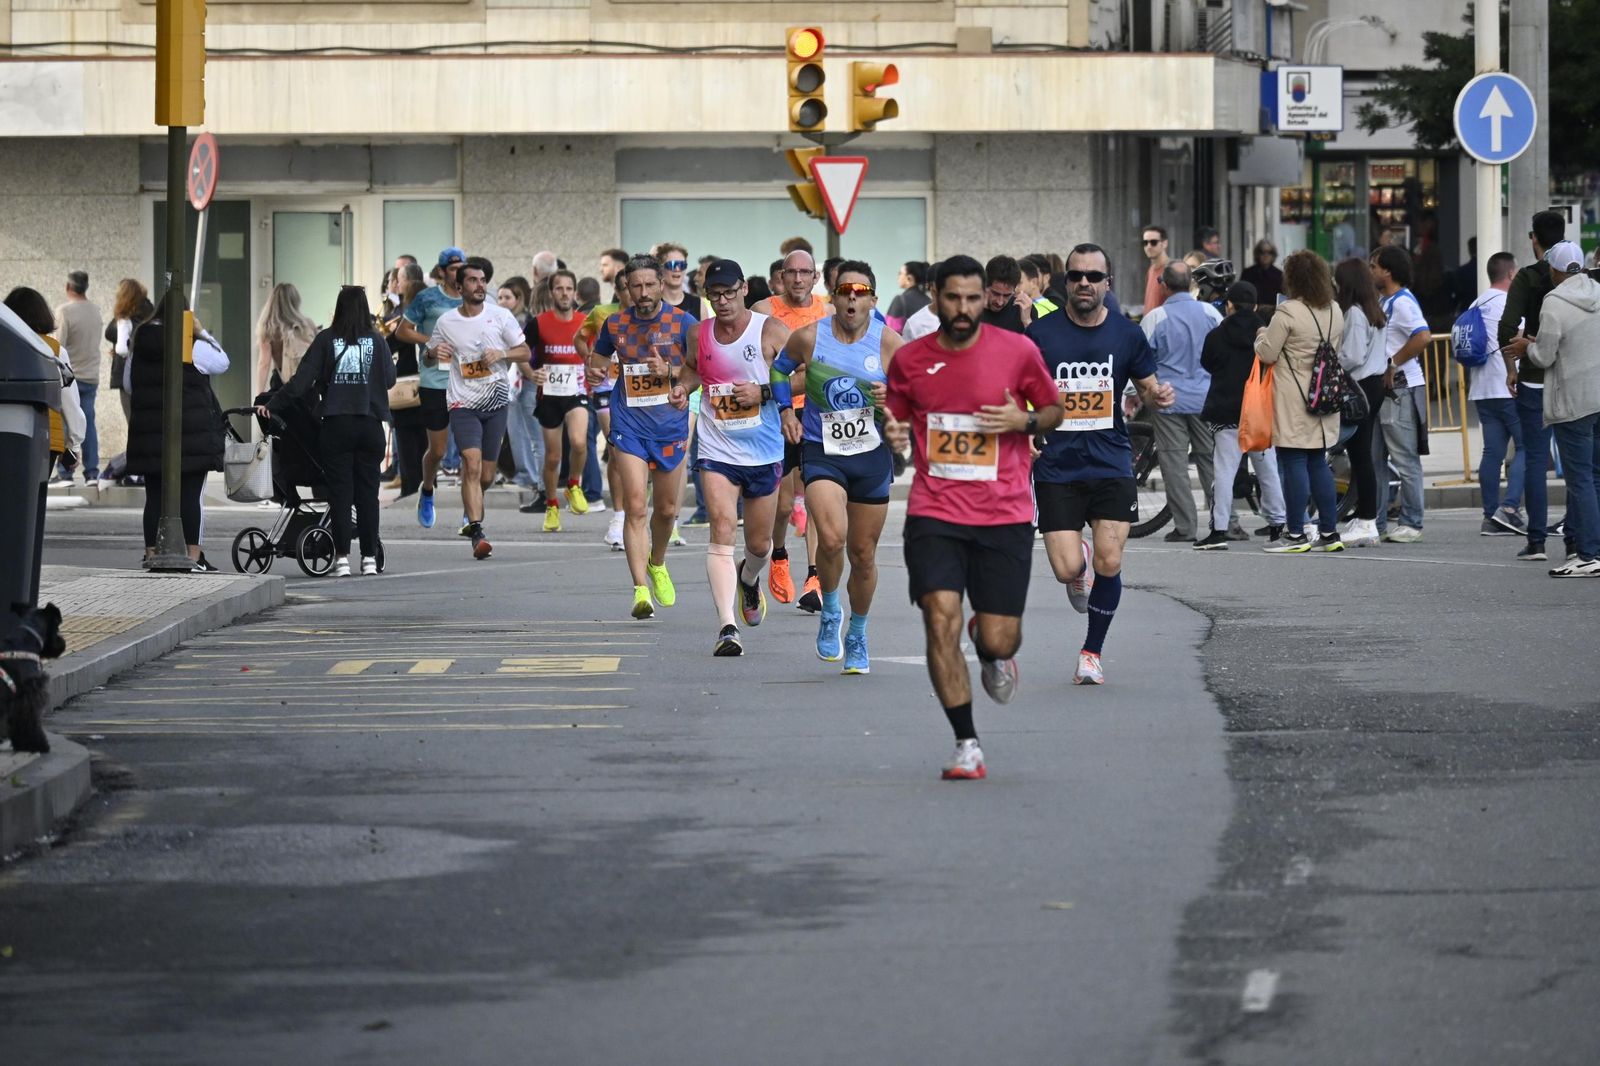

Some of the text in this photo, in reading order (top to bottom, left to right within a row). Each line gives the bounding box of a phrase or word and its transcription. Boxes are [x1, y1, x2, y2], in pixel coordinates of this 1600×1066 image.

[1056, 354, 1113, 379] mood
[549, 373, 571, 384] 647
[631, 376, 663, 391] 554
[841, 393, 860, 404] JD
[1065, 393, 1104, 411] 552
[831, 419, 869, 439] 802
[938, 432, 986, 456] 262
